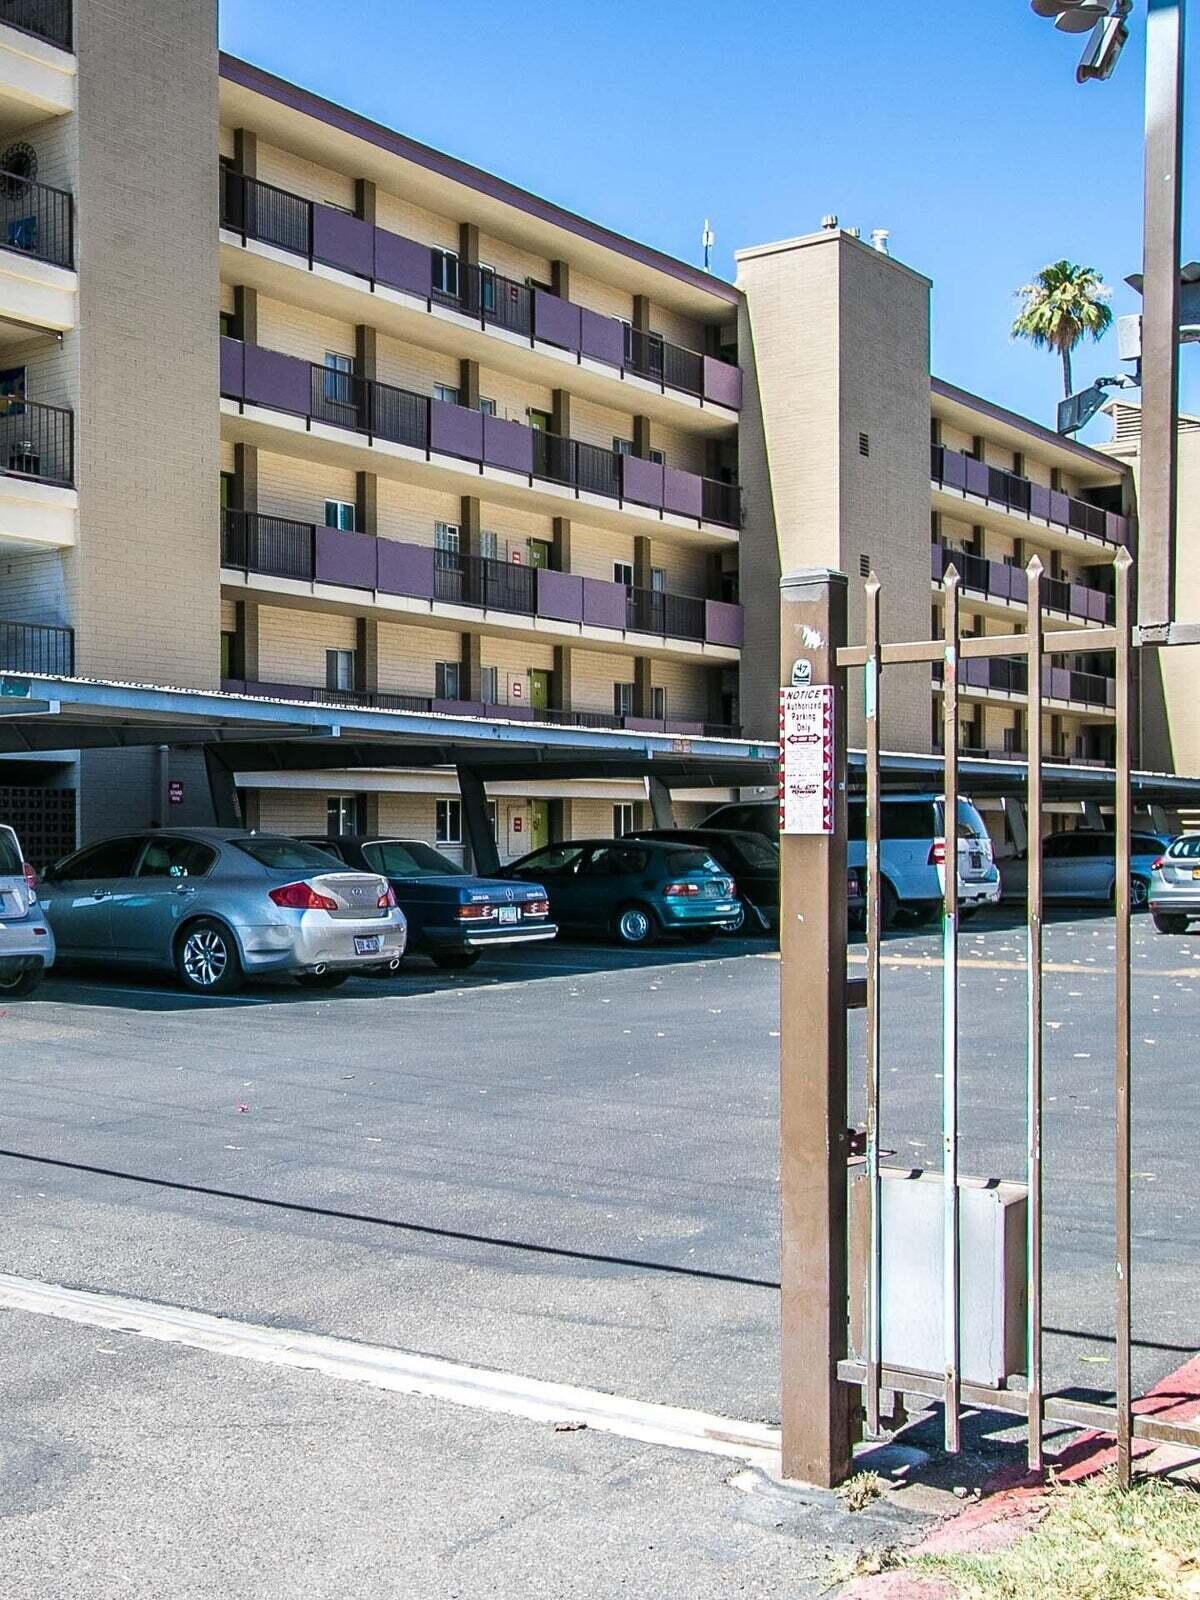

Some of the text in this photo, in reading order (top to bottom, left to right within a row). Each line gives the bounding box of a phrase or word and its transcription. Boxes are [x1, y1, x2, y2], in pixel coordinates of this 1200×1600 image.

[787, 690, 821, 700] NOTICE
[787, 702, 821, 710] Authorized
[792, 712, 816, 722] Parking
[797, 723, 810, 733] Only
